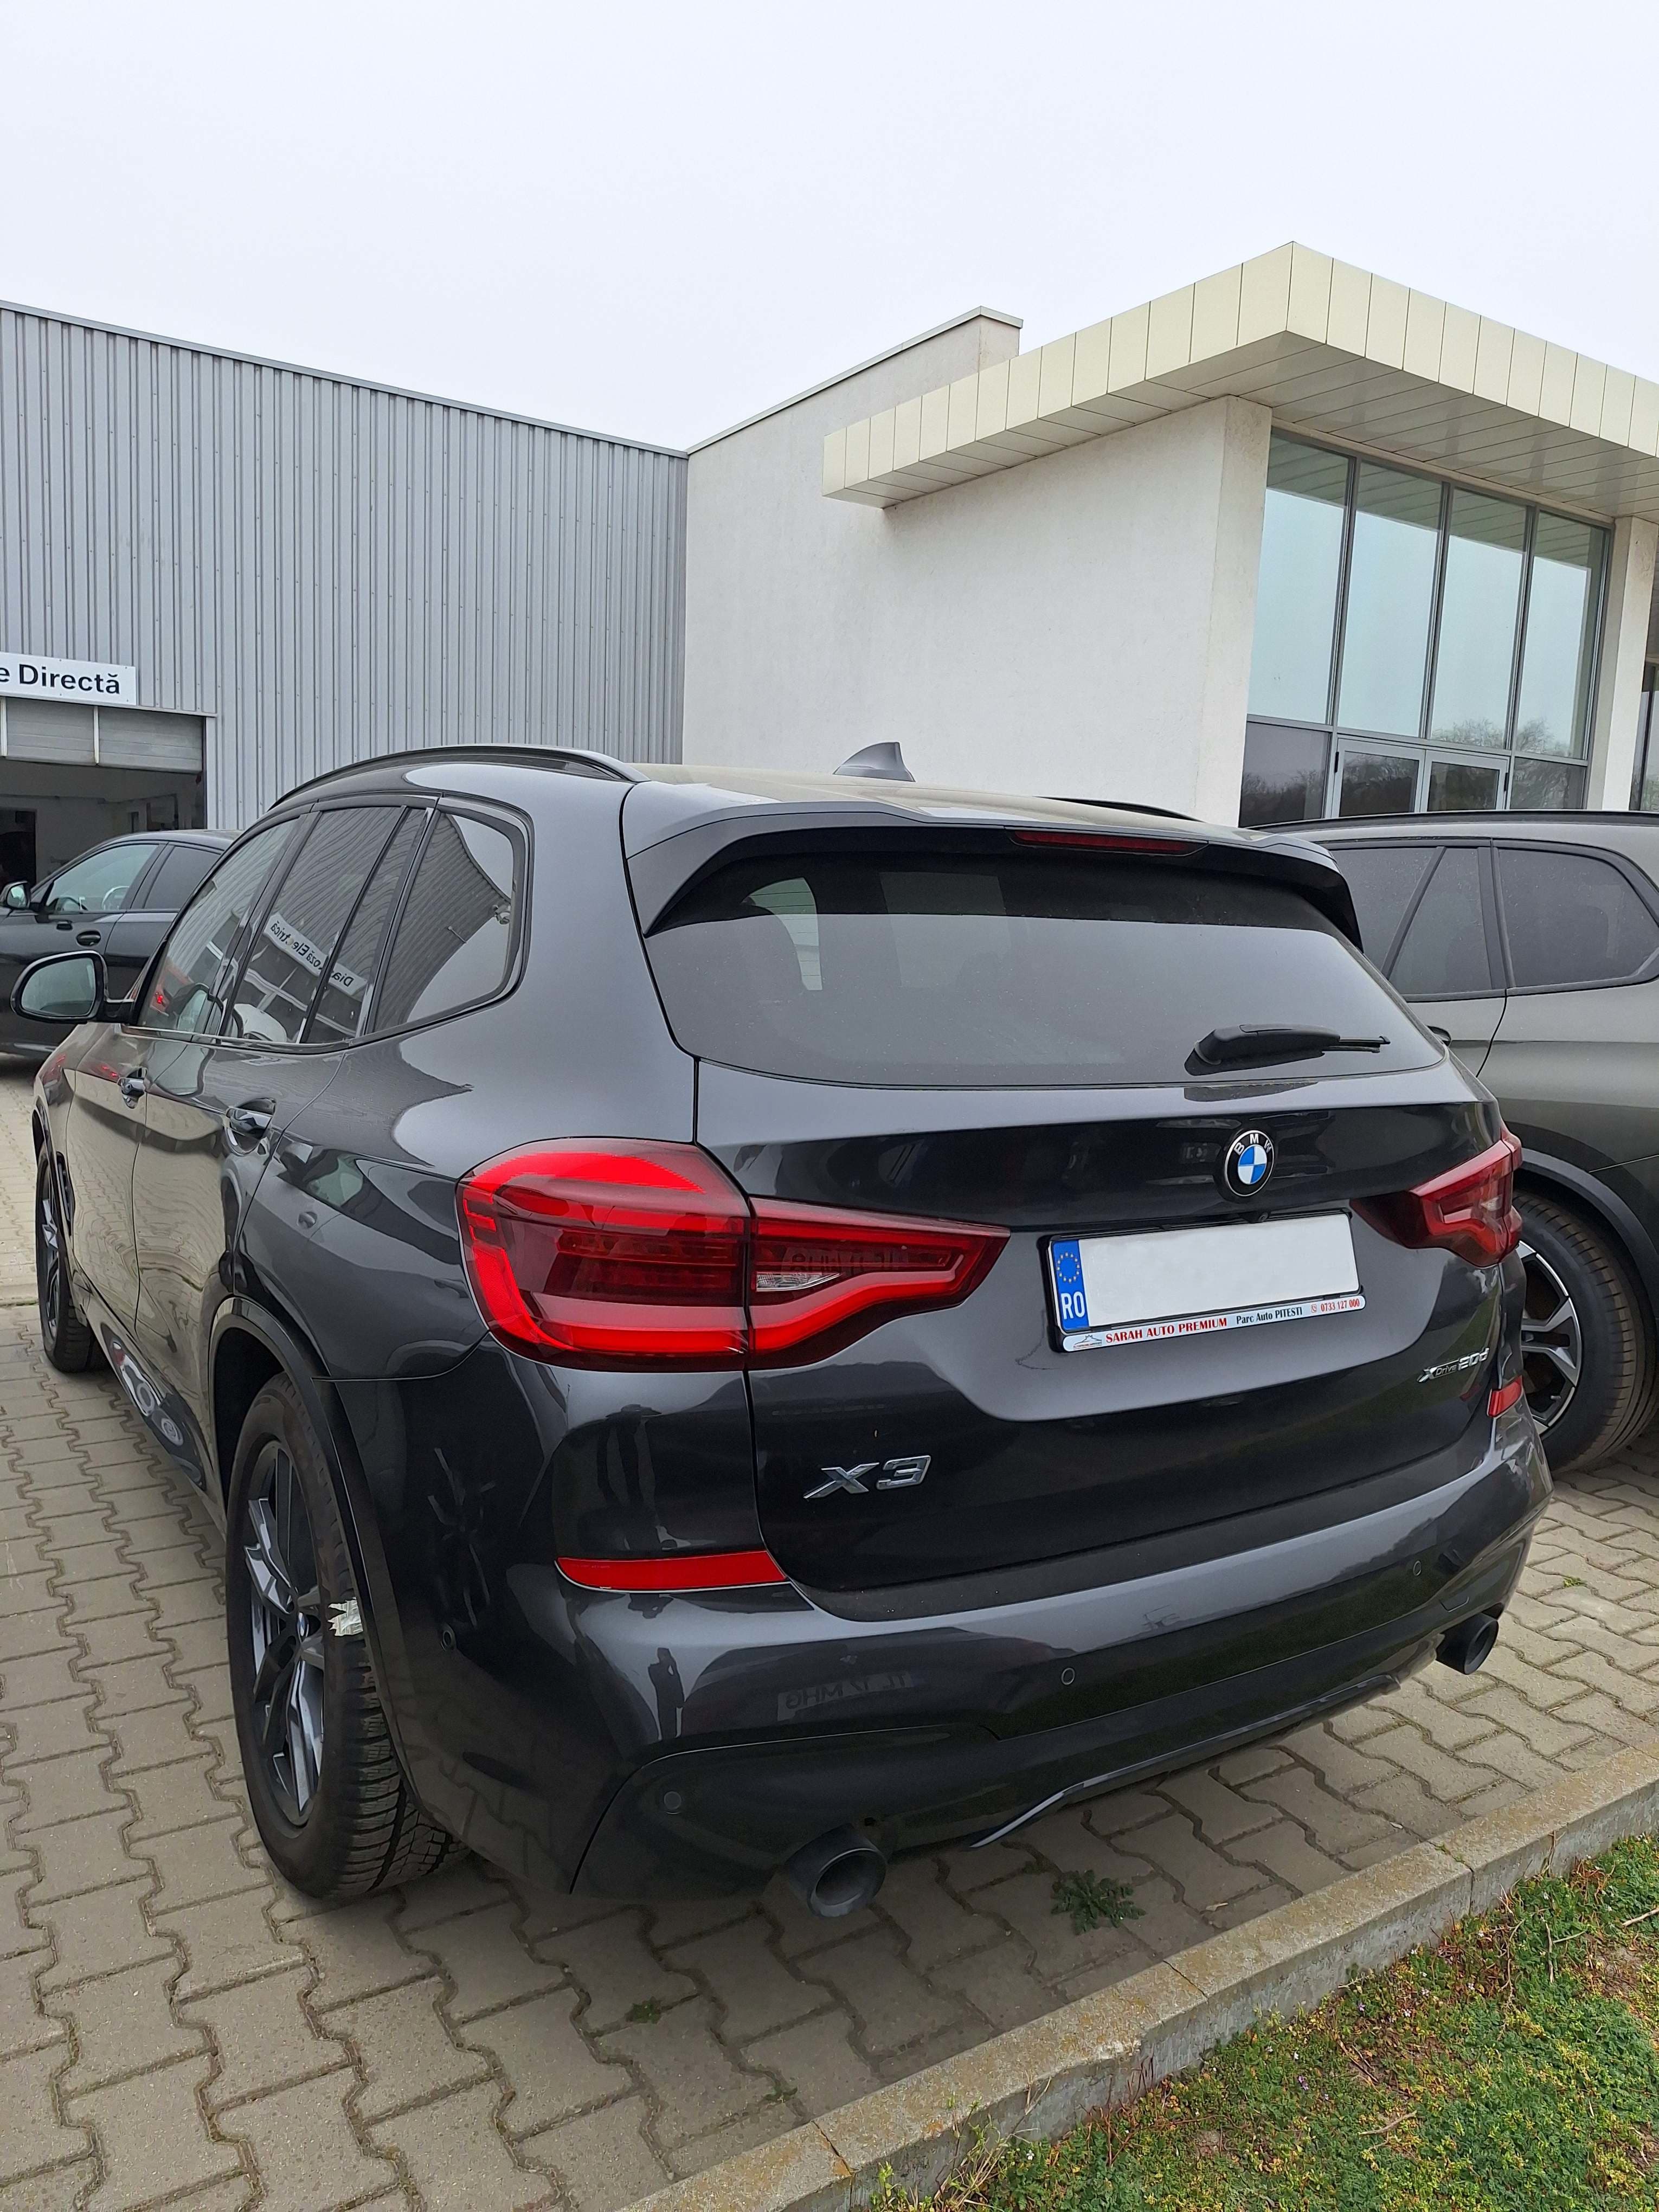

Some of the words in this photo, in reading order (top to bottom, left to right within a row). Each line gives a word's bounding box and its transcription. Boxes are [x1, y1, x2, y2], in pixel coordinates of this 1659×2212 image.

[18, 664, 120, 695] Directă
[1233, 1133, 1272, 1155] BMW
[1060, 1291, 1085, 1320] RO
[1105, 1329, 1143, 1343] SARAH
[1146, 1325, 1175, 1338] AUTO
[1178, 1317, 1227, 1333] PREMIUM
[1236, 1314, 1254, 1324] Parc
[1256, 1310, 1273, 1321] Auto
[1275, 1307, 1303, 1319] PITESTI
[1320, 1302, 1336, 1312] 0733
[1337, 1300, 1348, 1310] 127
[1349, 1298, 1360, 1308] 000
[803, 1455, 931, 1499] X3
